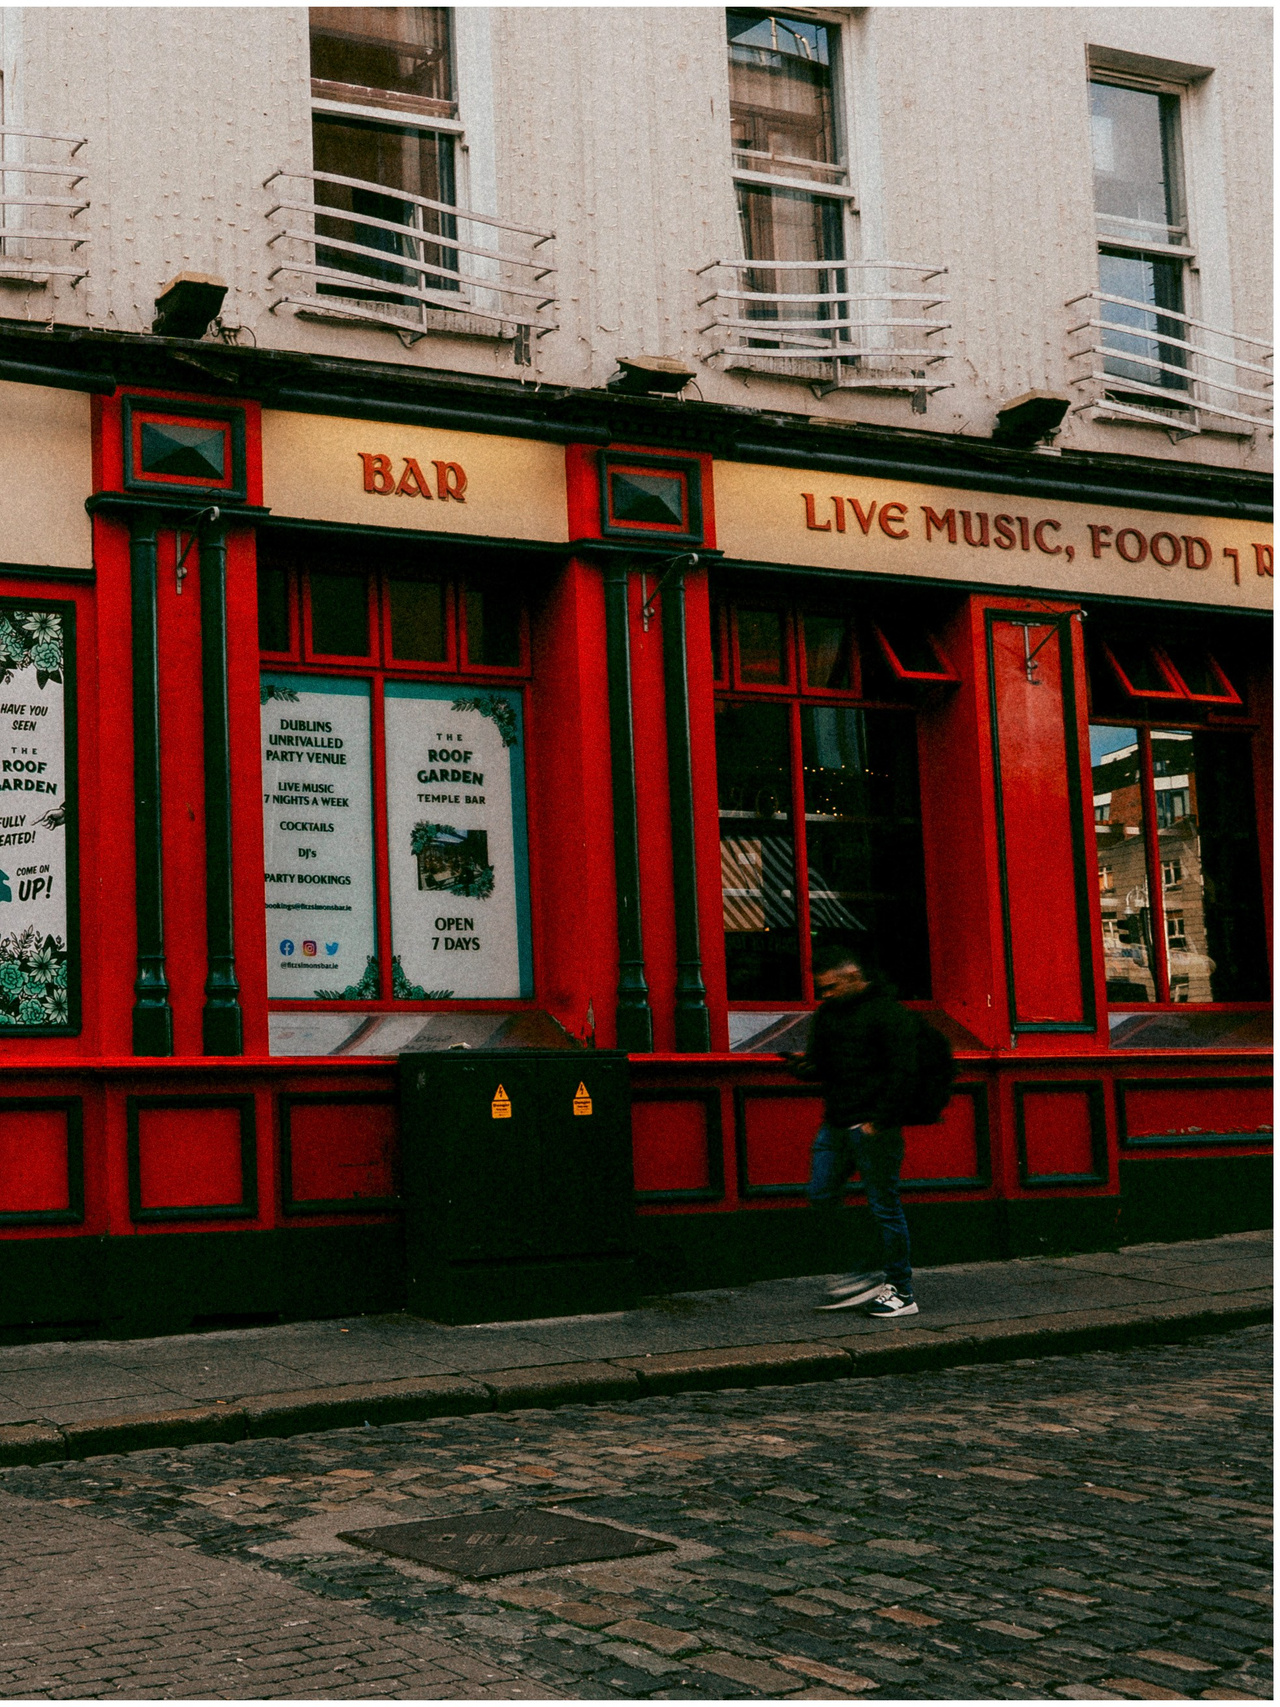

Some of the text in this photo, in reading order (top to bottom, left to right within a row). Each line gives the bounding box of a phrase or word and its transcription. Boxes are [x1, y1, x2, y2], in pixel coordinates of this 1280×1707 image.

[358, 452, 468, 504] BAR
[800, 492, 909, 540] LIVE
[920, 505, 1075, 563] MUSIC,
[1087, 522, 1213, 570] FOOD
[0, 703, 48, 717] HAVE YOU
[12, 720, 36, 732] SEEN
[280, 719, 332, 733] DUBLINS
[269, 734, 343, 749] UNRIVALLED
[436, 733, 463, 741] THE
[12, 747, 37, 755] THE
[266, 750, 347, 765] PARTY VENUE
[428, 749, 473, 763] ROOF
[2, 760, 47, 774] ROOF
[417, 769, 484, 786] GARDEN
[278, 782, 334, 793] LIVE MUSIC
[264, 794, 349, 807] 7 NIGHTS A WEEK
[417, 794, 486, 805] TEMPLE BAR
[280, 821, 334, 832] COCKTAILS
[298, 848, 317, 860] DJ's
[16, 864, 50, 876] COME ON
[265, 873, 351, 885] PARTY BOOKINGS
[19, 876, 53, 902] UP!
[435, 917, 474, 931] OPEN
[431, 937, 480, 950] 7 DAYS
